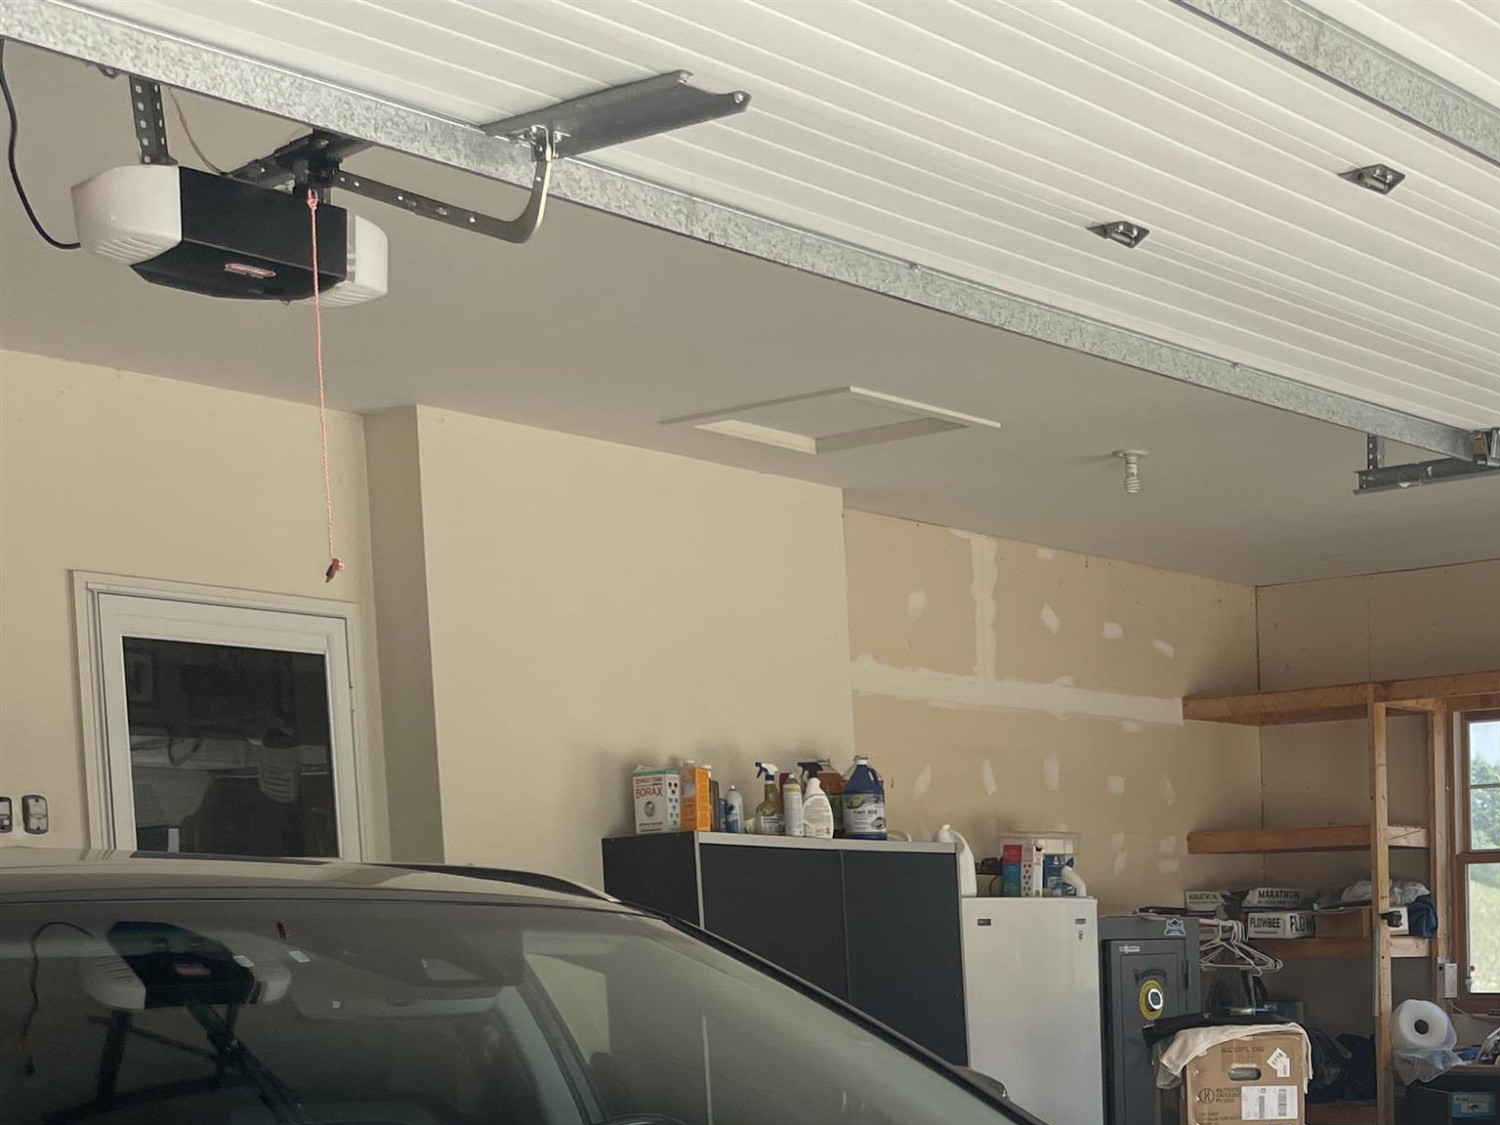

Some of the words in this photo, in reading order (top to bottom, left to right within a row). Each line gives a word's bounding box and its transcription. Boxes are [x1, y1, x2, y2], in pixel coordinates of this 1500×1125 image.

[635, 786, 663, 799] BORAX
[1258, 890, 1300, 899] MARATHON
[1249, 916, 1281, 929] FLOWBEE
